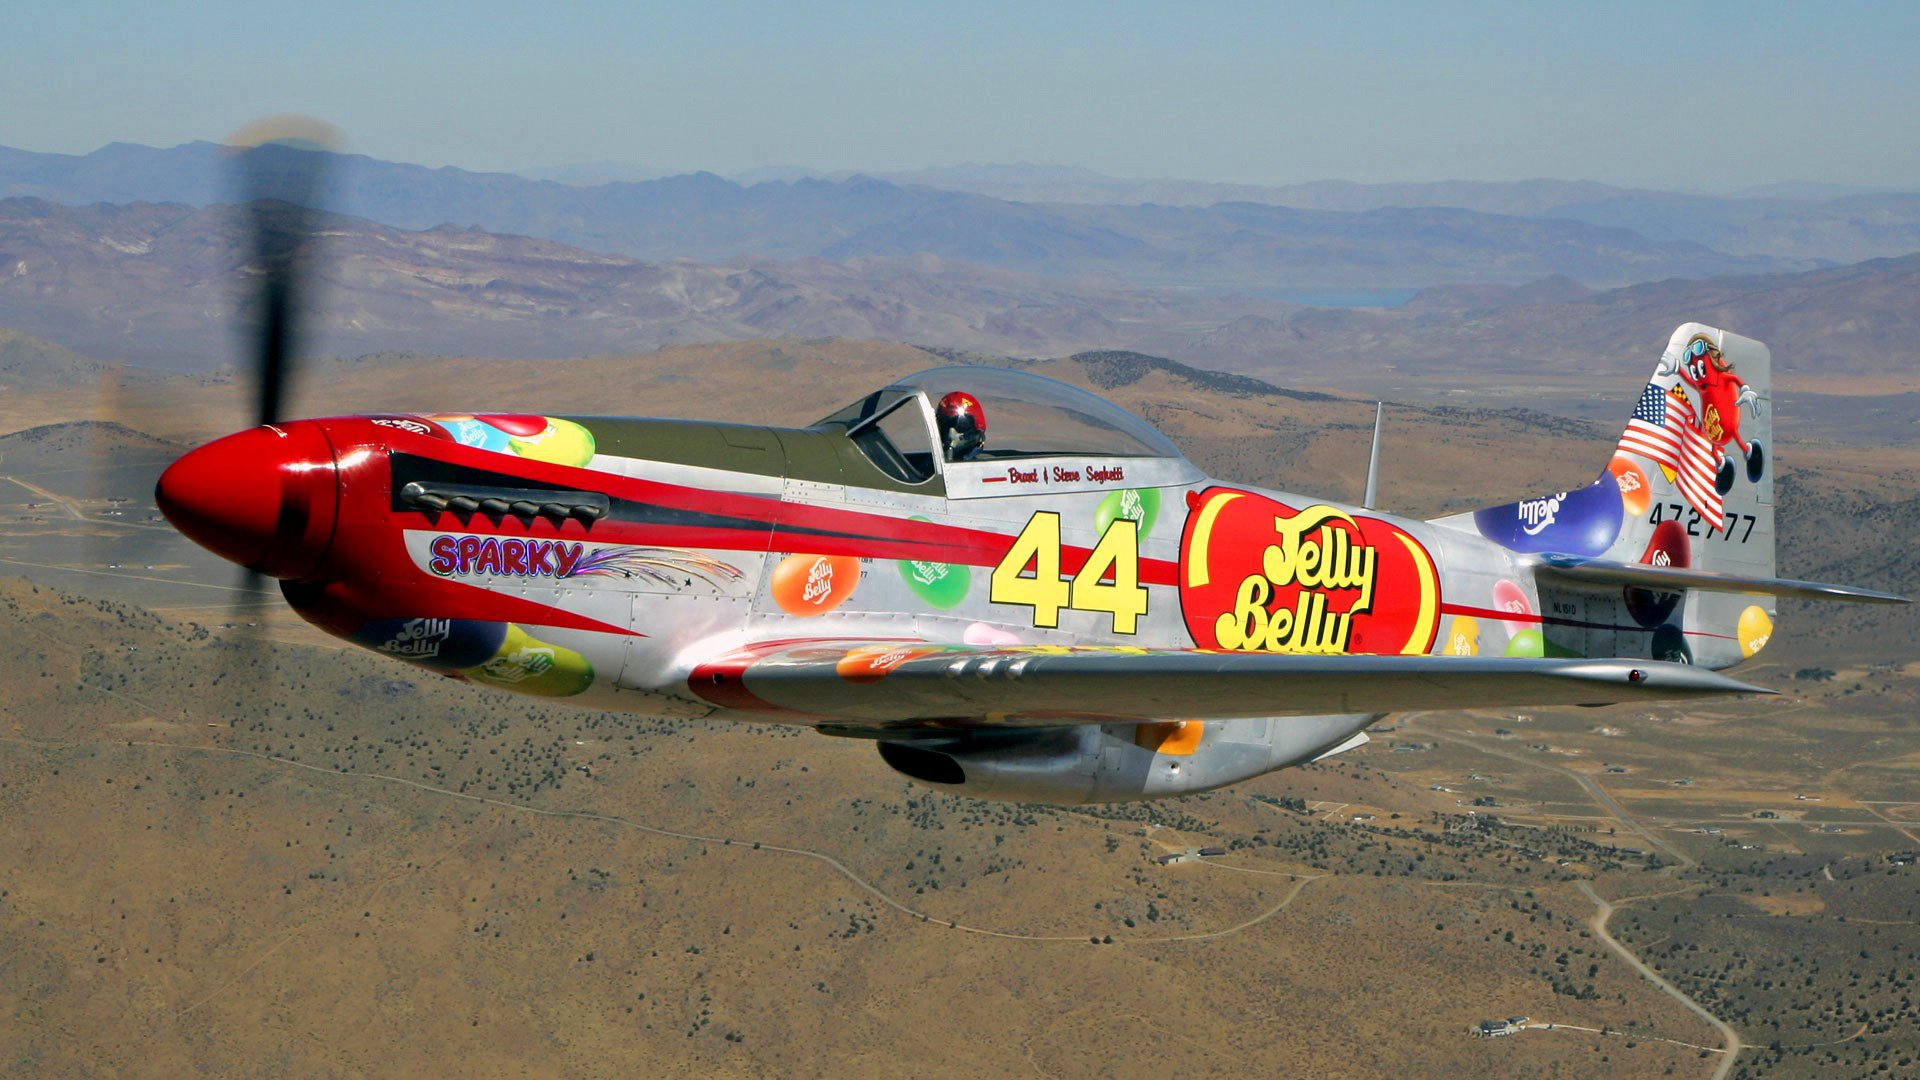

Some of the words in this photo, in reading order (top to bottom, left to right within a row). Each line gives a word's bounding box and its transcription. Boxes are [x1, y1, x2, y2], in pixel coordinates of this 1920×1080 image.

[1053, 466, 1081, 482] Steve
[1518, 498, 1560, 536] Jelly
[430, 535, 583, 579] SPARKY
[808, 557, 833, 583] Jelly
[990, 511, 1148, 635] 44
[1263, 504, 1377, 614] Jelly
[803, 579, 832, 605] Belly
[1215, 574, 1352, 653] Belly
[396, 618, 450, 642] Jelly
[376, 639, 440, 658] Belly
